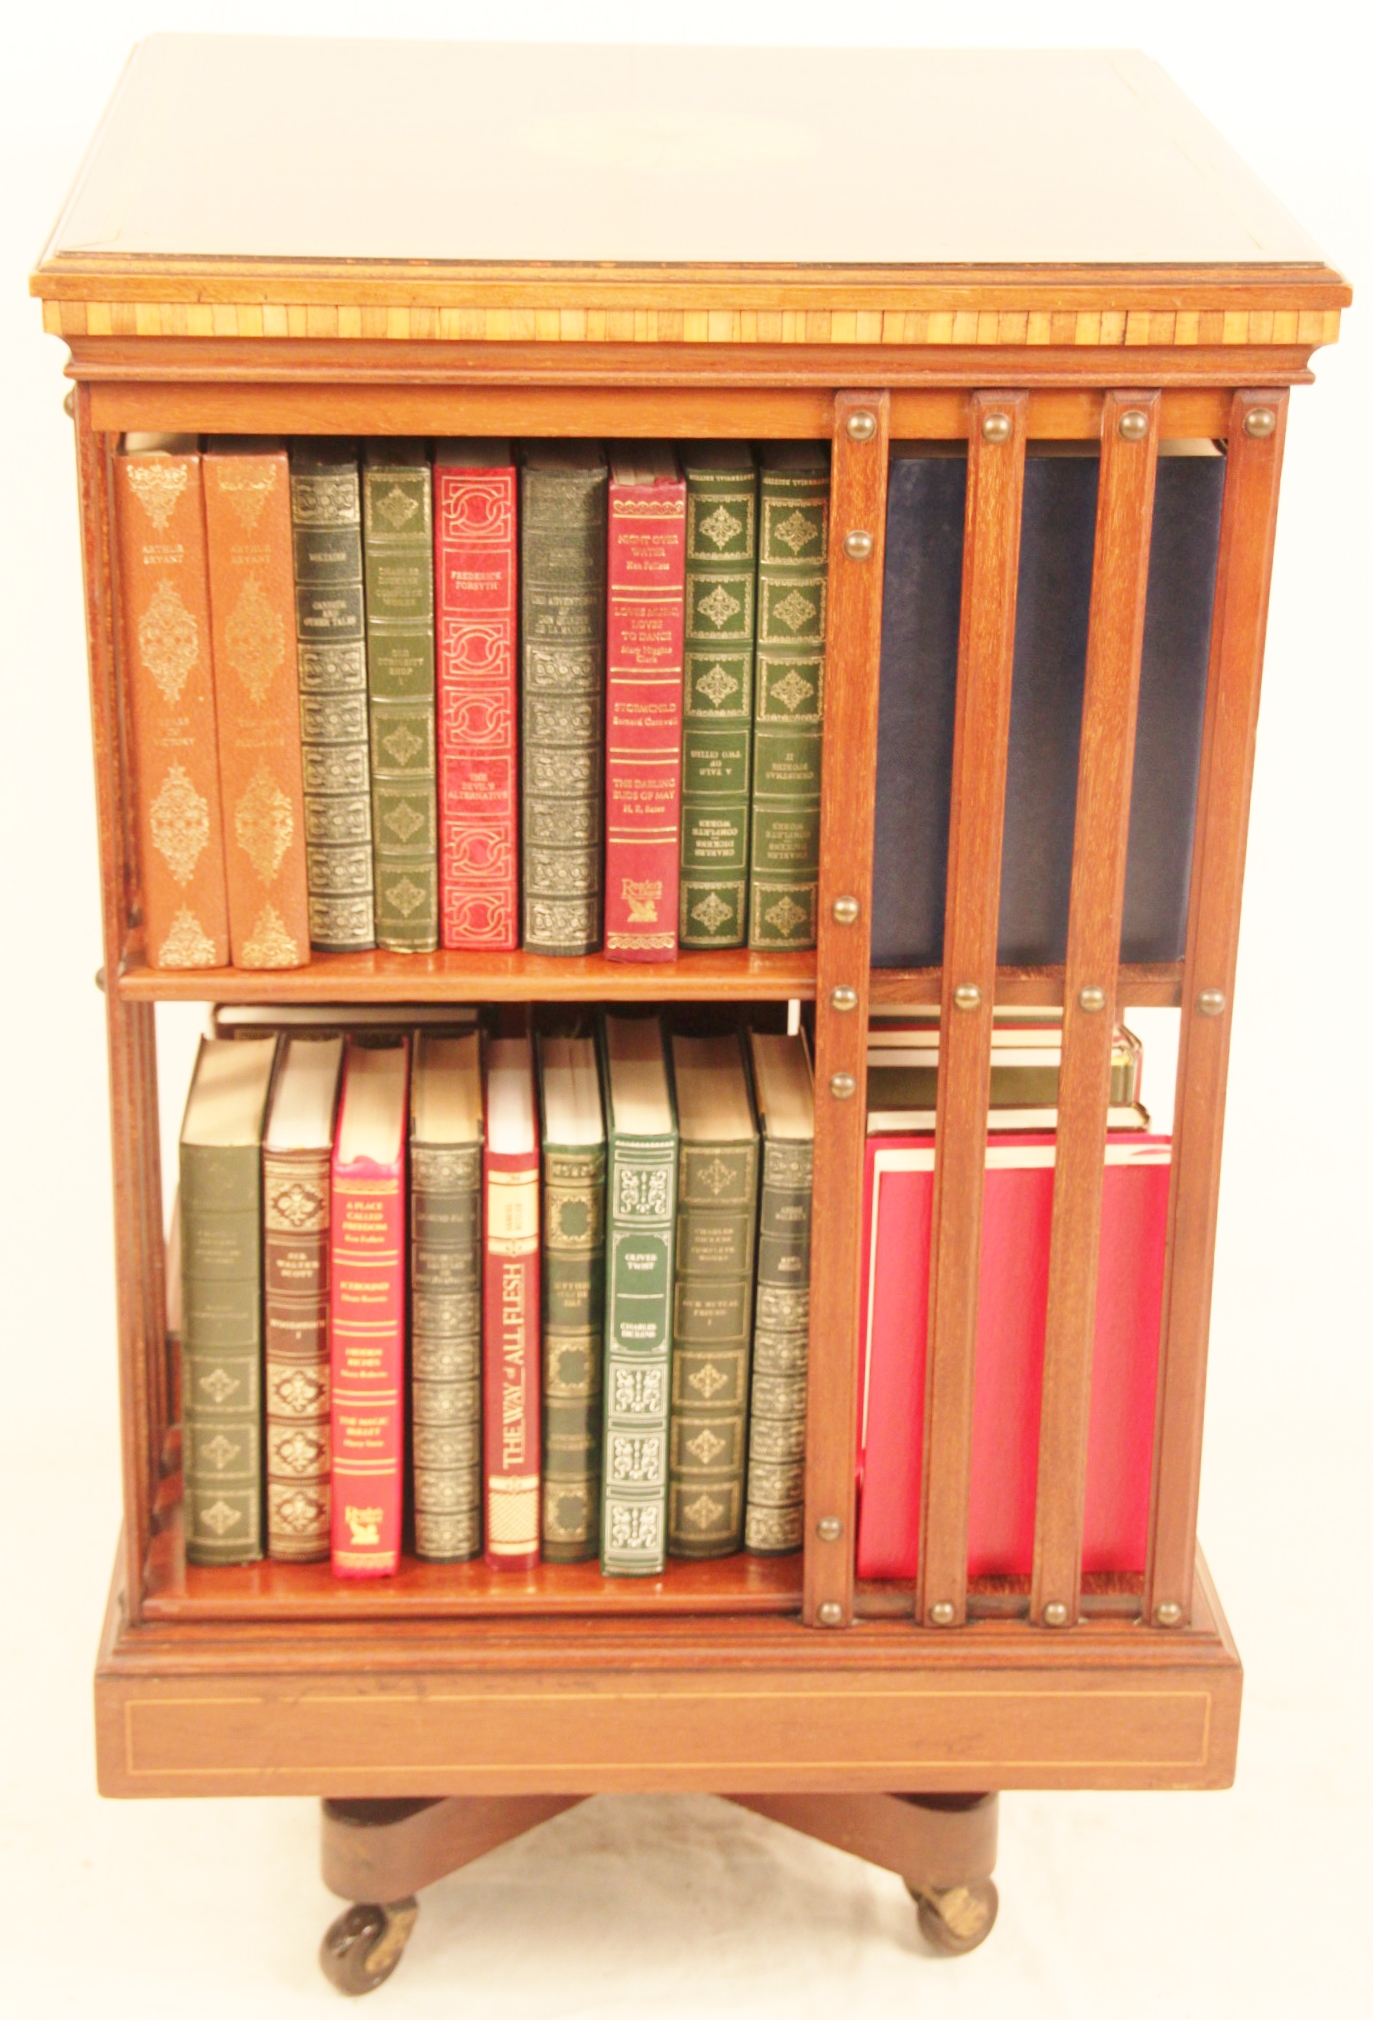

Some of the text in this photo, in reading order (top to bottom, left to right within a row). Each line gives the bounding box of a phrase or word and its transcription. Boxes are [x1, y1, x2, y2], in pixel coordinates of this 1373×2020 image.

[618, 534, 679, 545] NIGHT OVER
[142, 544, 184, 554] ARTHUR
[631, 547, 666, 557] WATER
[143, 554, 183, 565] BRYANT
[451, 571, 502, 581] FREDERICK
[456, 581, 498, 591] FORSYTH
[614, 607, 646, 617] LOVES
[631, 619, 663, 629] LOVES
[621, 631, 672, 641] TO DANCE
[614, 703, 677, 713] STORMCHILD
[690, 750, 742, 759] TWO CITIES
[710, 760, 722, 768] OF
[469, 773, 488, 781] THE
[699, 768, 722, 776] TALE
[613, 778, 677, 789] THE DARLING
[448, 791, 508, 800] ALTERNATIVE
[613, 790, 677, 800] BUDS OF MAY
[699, 819, 731, 828] WORKS
[692, 828, 738, 837] COMPLETE
[696, 840, 734, 848] DICKENS
[694, 849, 735, 857] CHARLES
[346, 1201, 384, 1211] A PLACE
[346, 1211, 384, 1221] CALLED
[342, 1221, 388, 1231] FREEDOM
[624, 1253, 657, 1262] OLIVER
[276, 1259, 320, 1269] WALTER
[627, 1261, 655, 1271] TWIST
[281, 1269, 313, 1278] SCOTT
[503, 1263, 525, 1325] FLESH
[620, 1322, 657, 1331] CHARLES
[621, 1330, 657, 1339] DICKENS
[503, 1328, 525, 1366] ALL
[503, 1383, 525, 1425] WAY
[503, 1426, 525, 1471] THE
